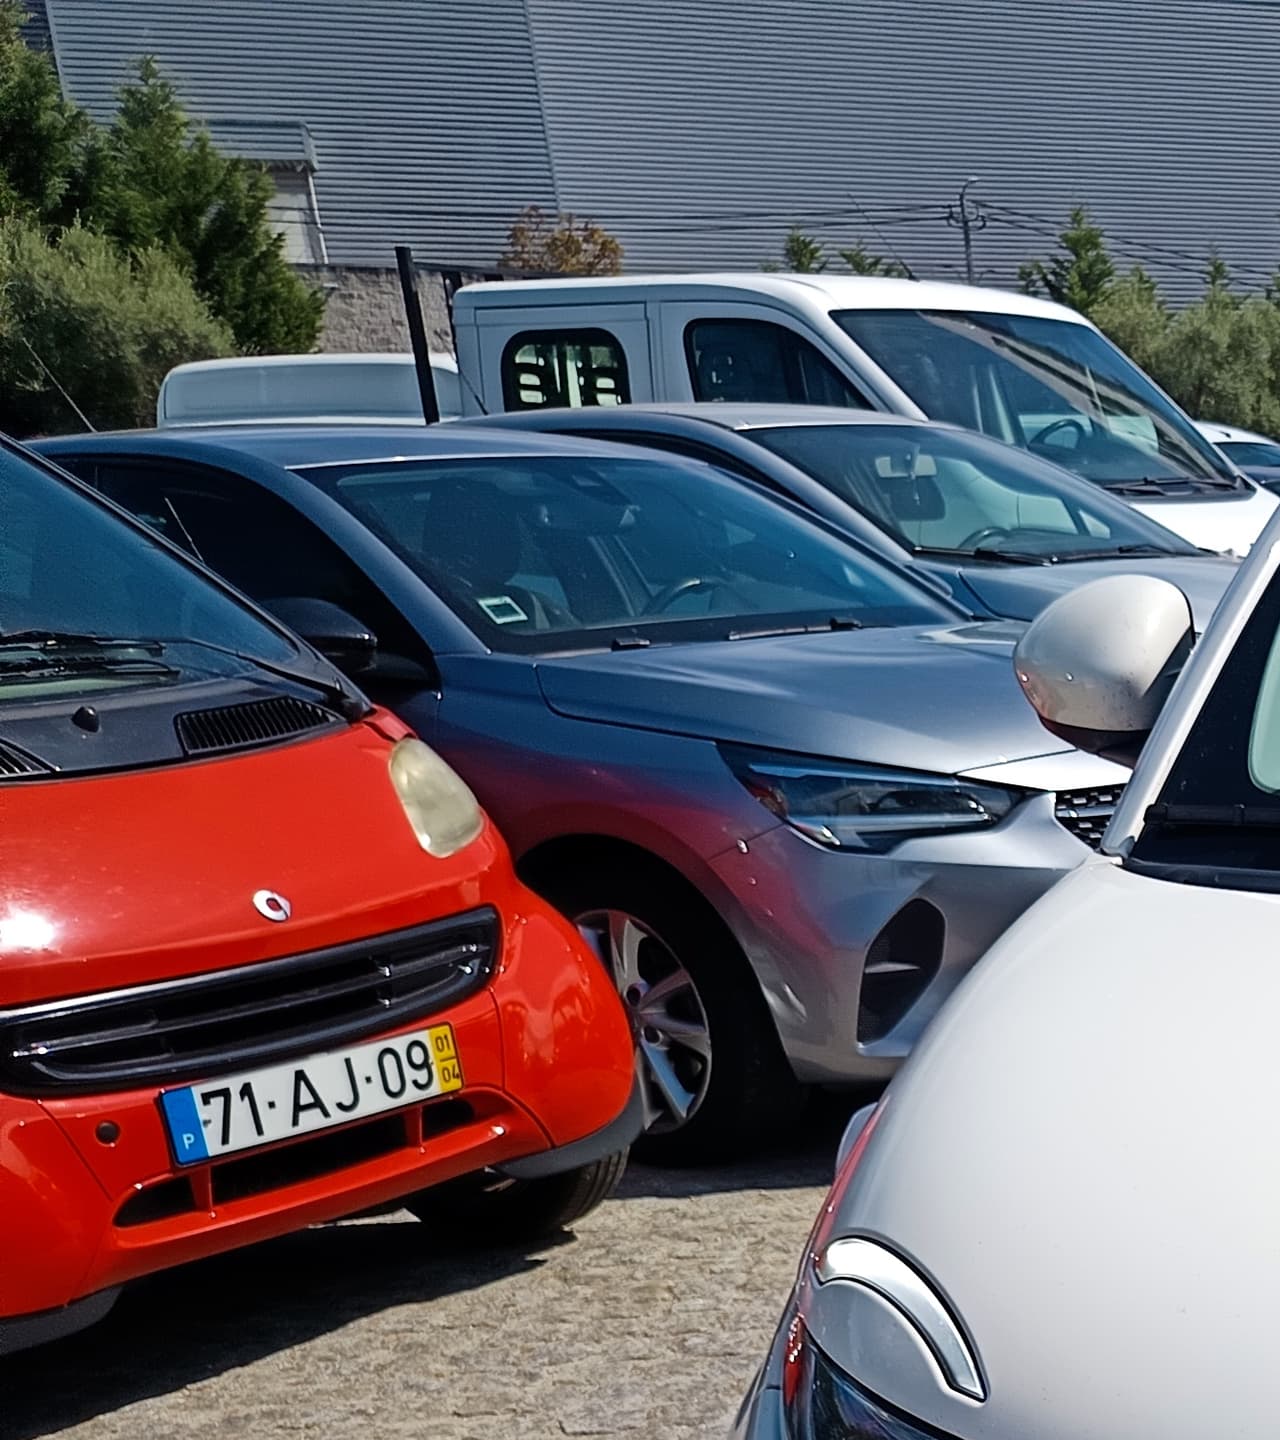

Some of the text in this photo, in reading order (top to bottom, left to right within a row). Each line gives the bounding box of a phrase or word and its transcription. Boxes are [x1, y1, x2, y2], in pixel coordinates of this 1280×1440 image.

[434, 1034, 451, 1052] 01
[441, 1062, 461, 1084] 04
[182, 1133, 195, 1149] P
